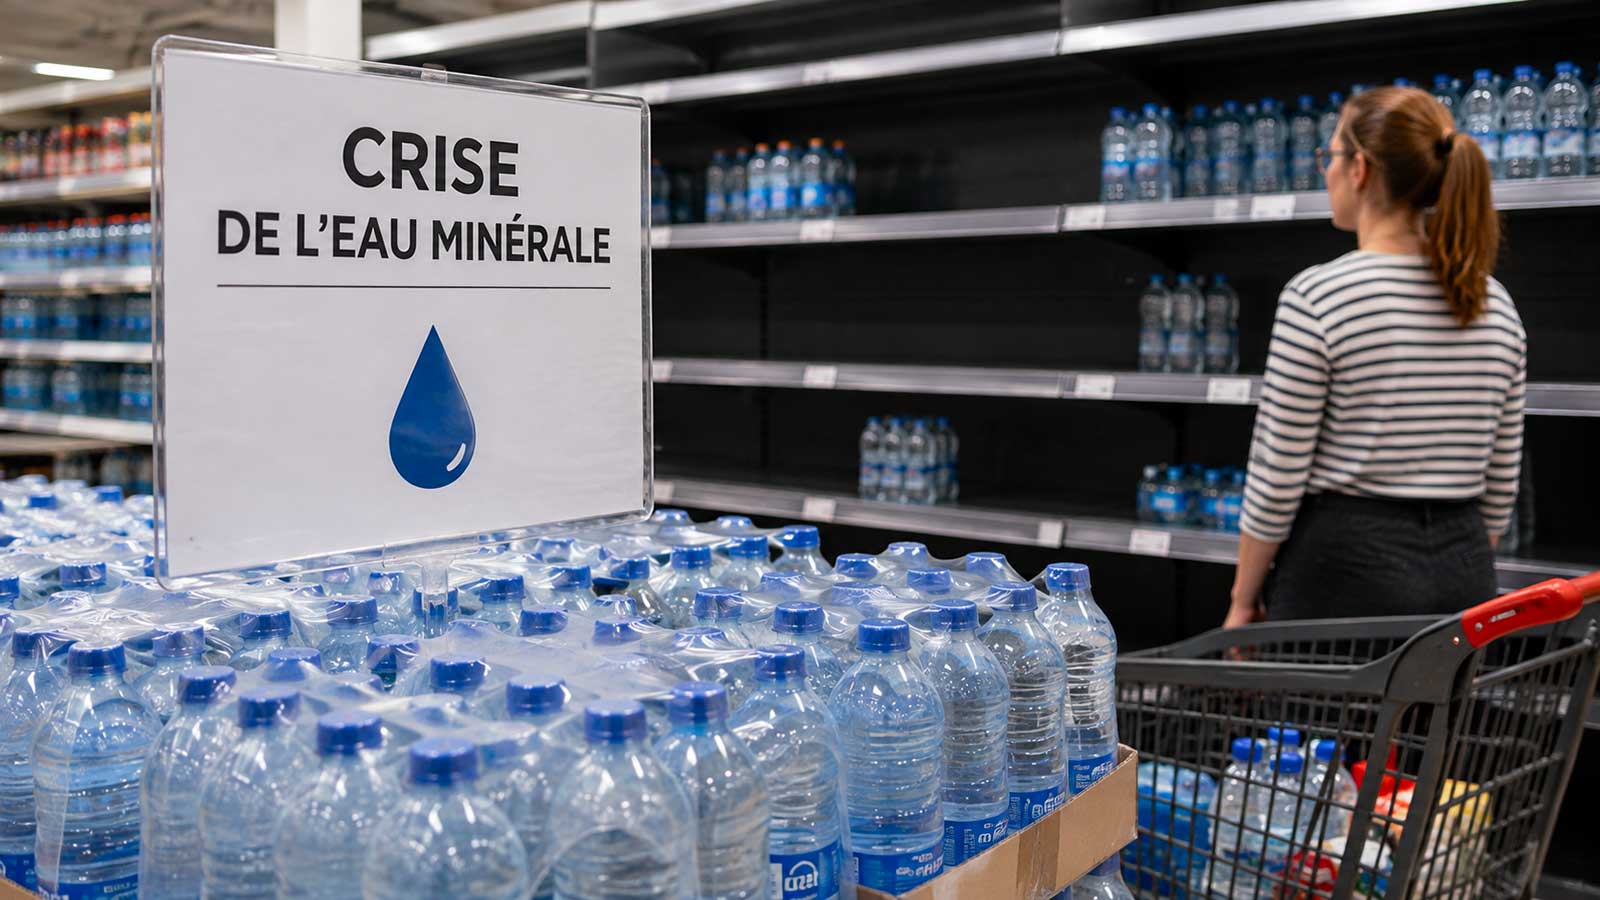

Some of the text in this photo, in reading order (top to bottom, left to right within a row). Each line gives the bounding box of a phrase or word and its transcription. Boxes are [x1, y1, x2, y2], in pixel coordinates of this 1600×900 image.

[343, 127, 519, 197] CRISE
[218, 210, 611, 264] DE L’EAU MINÉRALE
